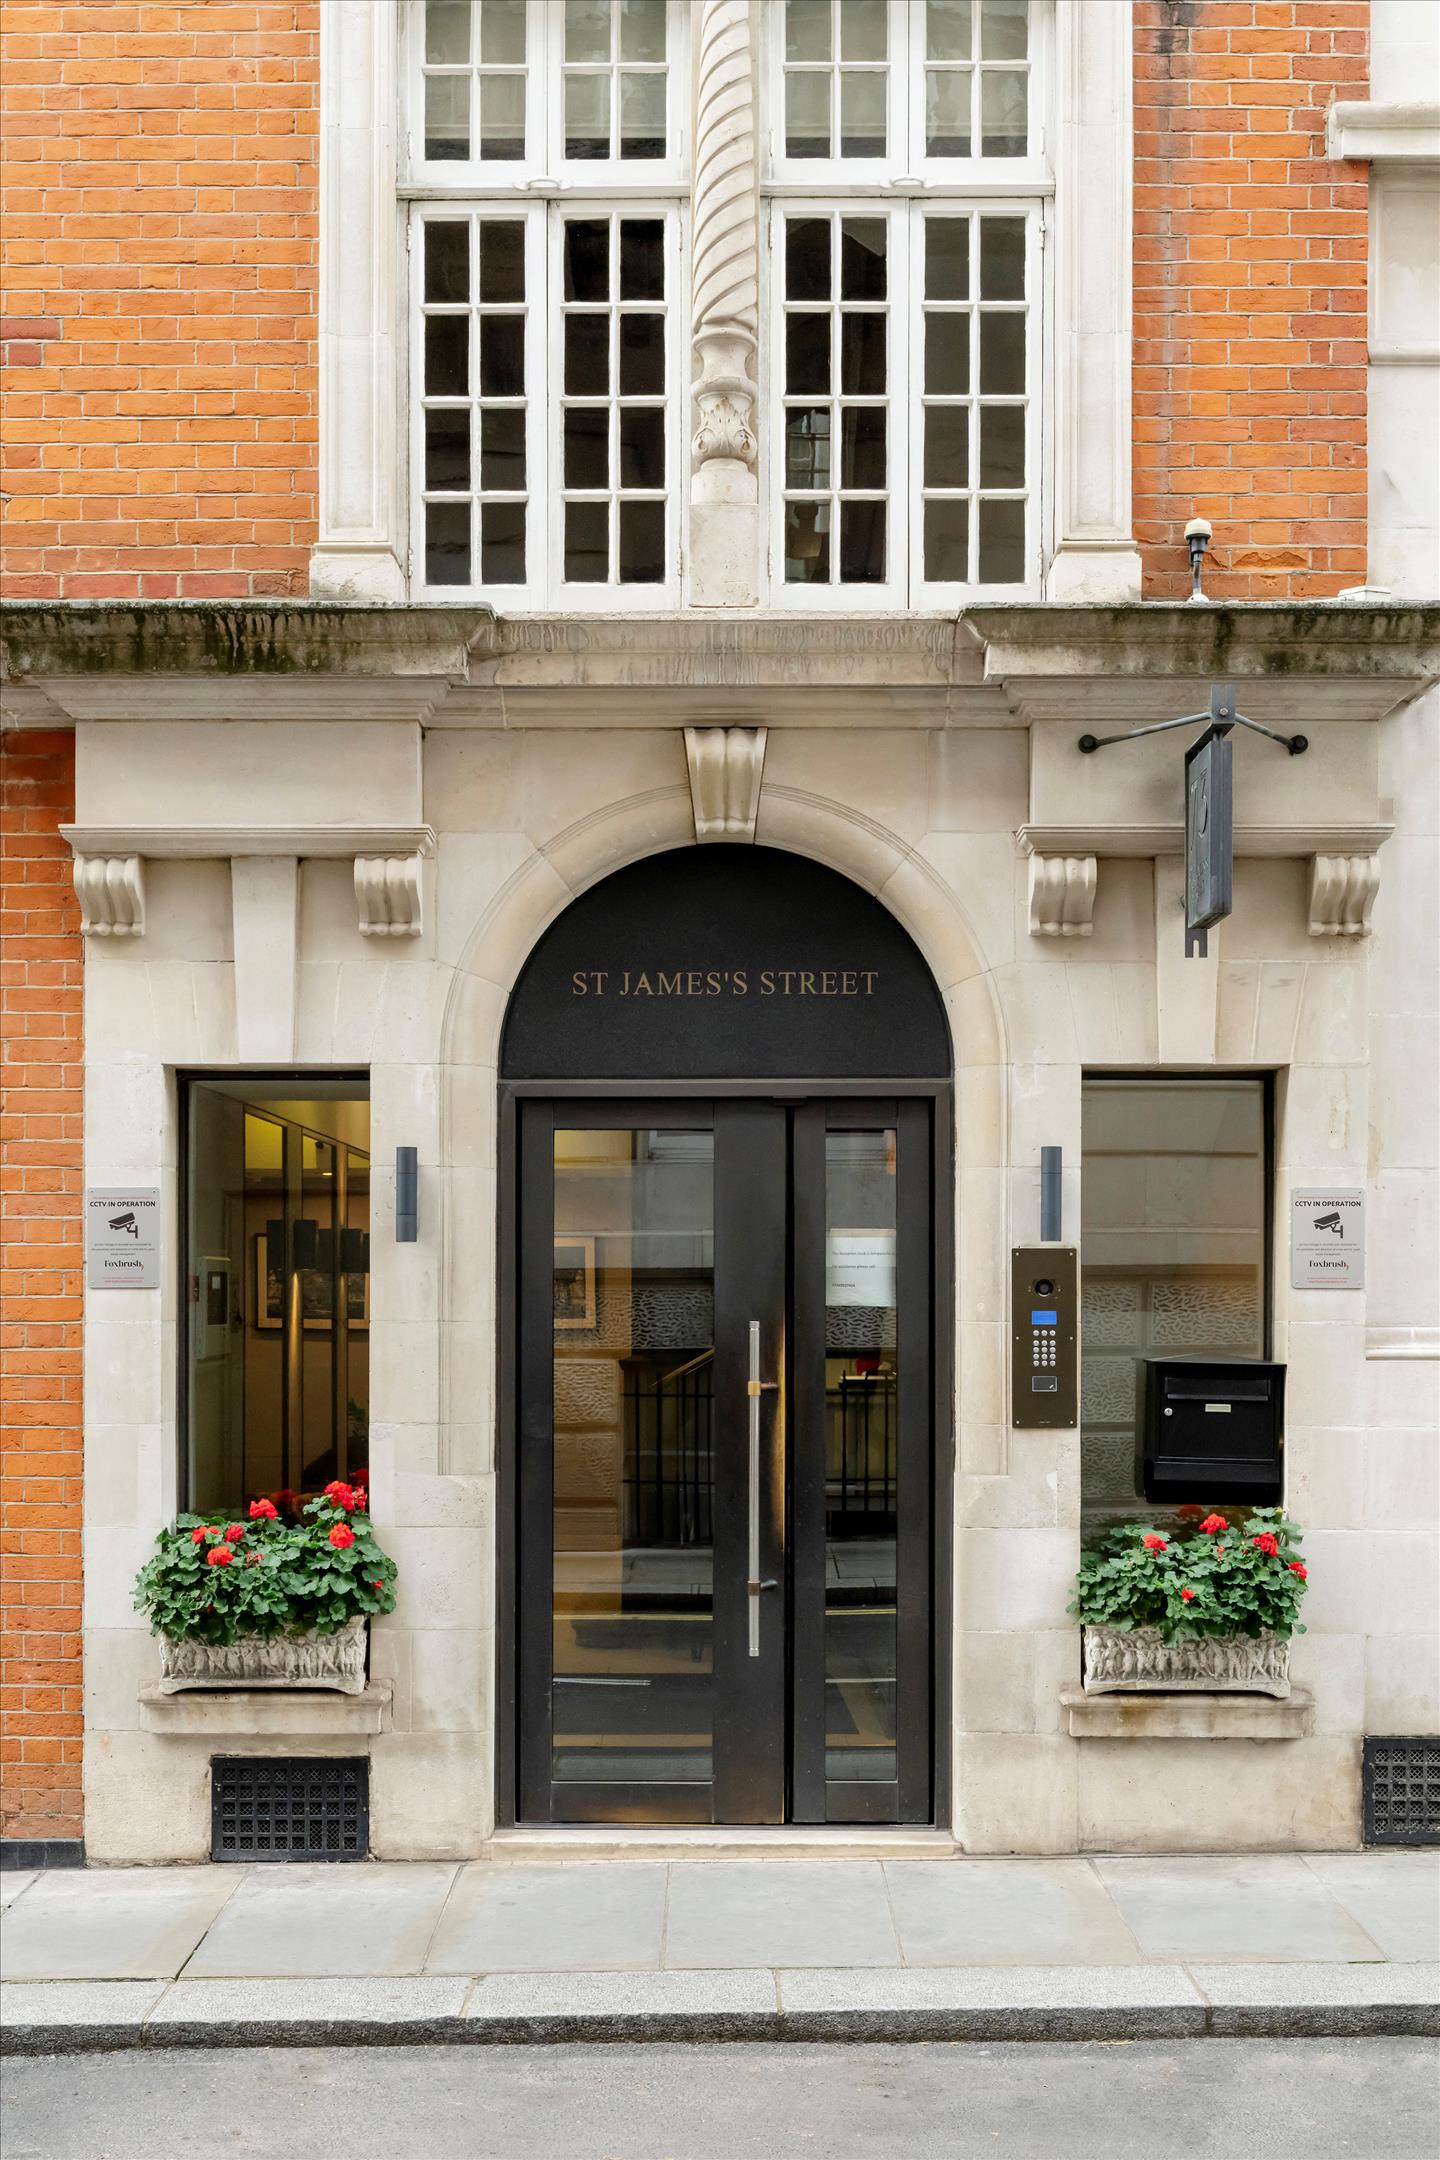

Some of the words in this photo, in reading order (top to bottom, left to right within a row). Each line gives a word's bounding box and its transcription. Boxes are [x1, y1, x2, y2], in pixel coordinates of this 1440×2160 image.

[572, 971, 609, 996] ST
[619, 971, 748, 996] JAMES'S
[760, 971, 880, 996] STREET
[104, 1260, 143, 1269] Foxbrush
[1309, 1260, 1348, 1269] Foxbrush
